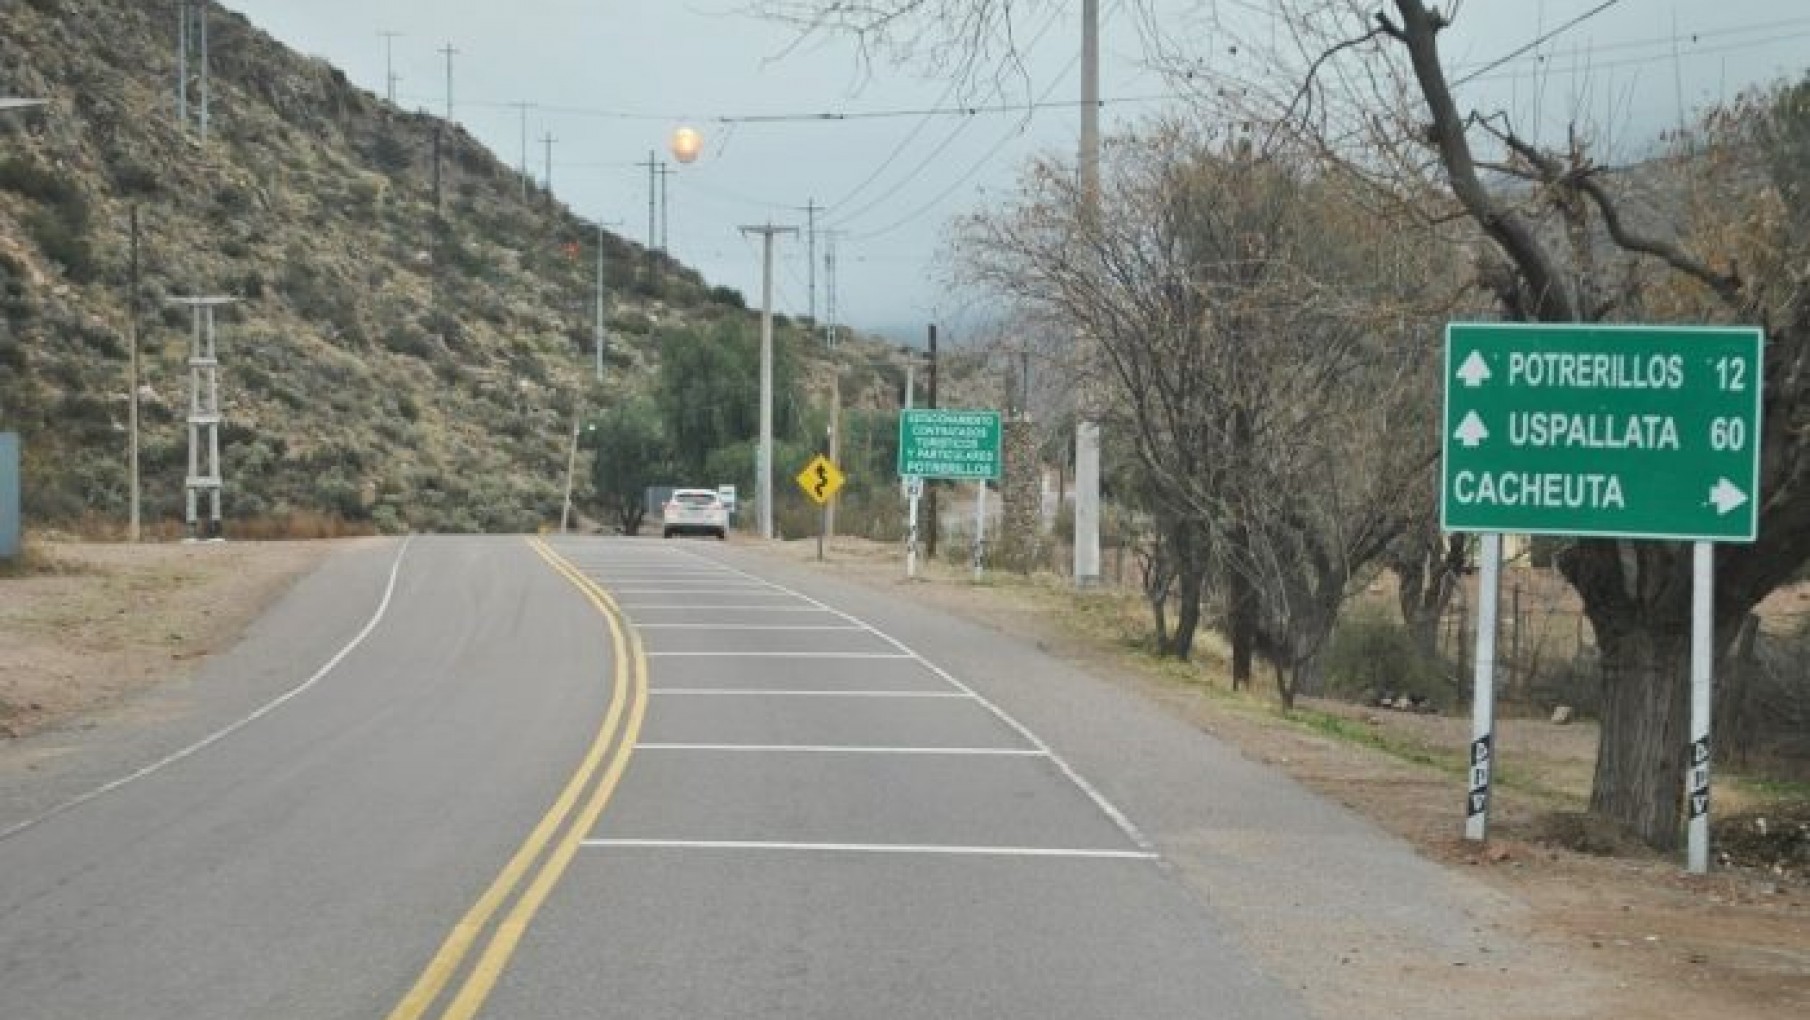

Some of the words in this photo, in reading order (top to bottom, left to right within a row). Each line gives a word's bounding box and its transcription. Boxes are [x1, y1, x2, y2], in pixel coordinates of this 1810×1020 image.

[1508, 351, 1684, 389] POTRERILLOS
[1715, 356, 1747, 392] 12
[1509, 411, 1680, 450] USPALLATA
[1710, 416, 1746, 451] 60
[907, 460, 991, 475] POTRERILLOS
[917, 448, 993, 461] PARTICULARES
[1454, 471, 1625, 508] CACHEUTA
